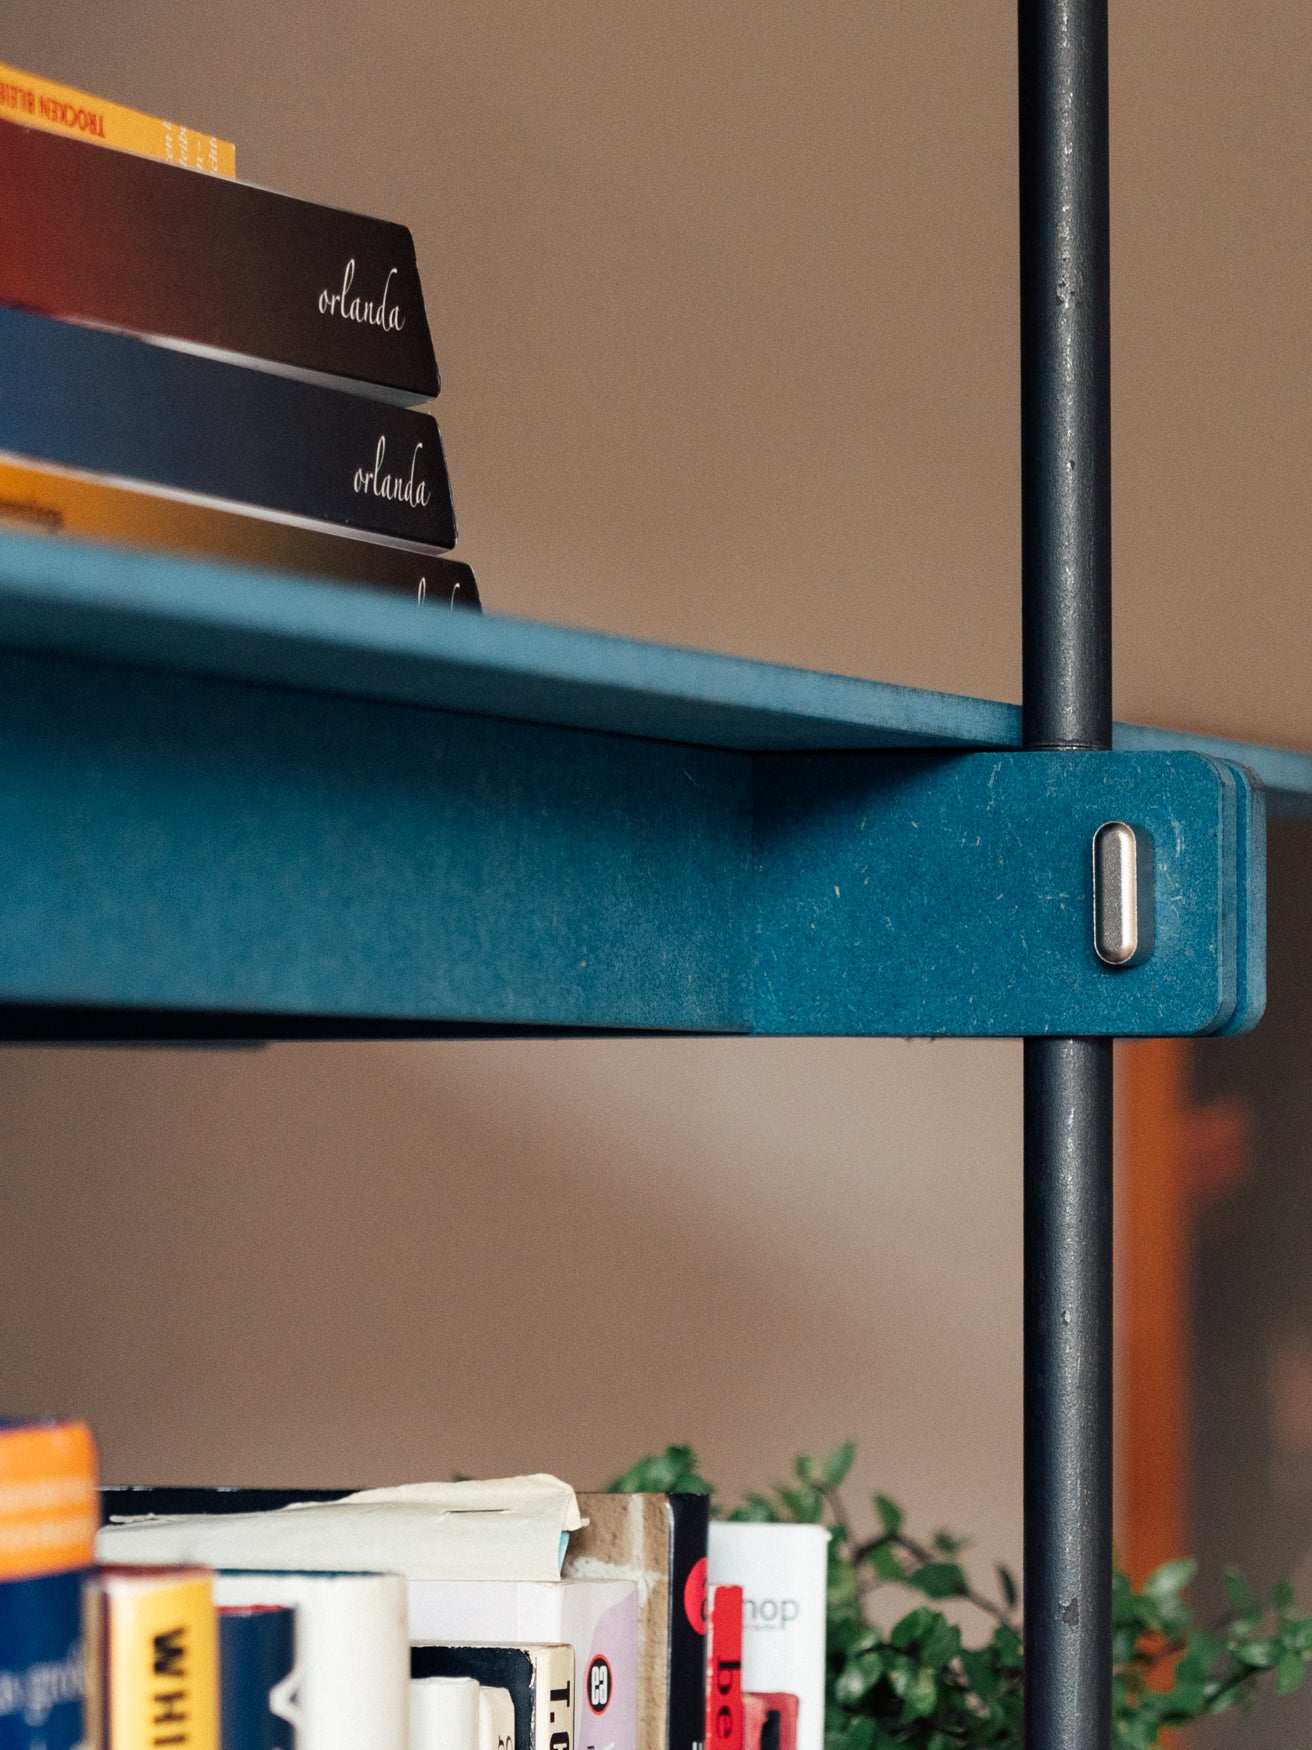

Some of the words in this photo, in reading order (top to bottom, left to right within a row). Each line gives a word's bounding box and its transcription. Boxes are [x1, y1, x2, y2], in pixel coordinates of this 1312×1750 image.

[39, 93, 106, 139] TROCKEN
[318, 258, 406, 332] orlanda
[353, 435, 431, 508] orlanda
